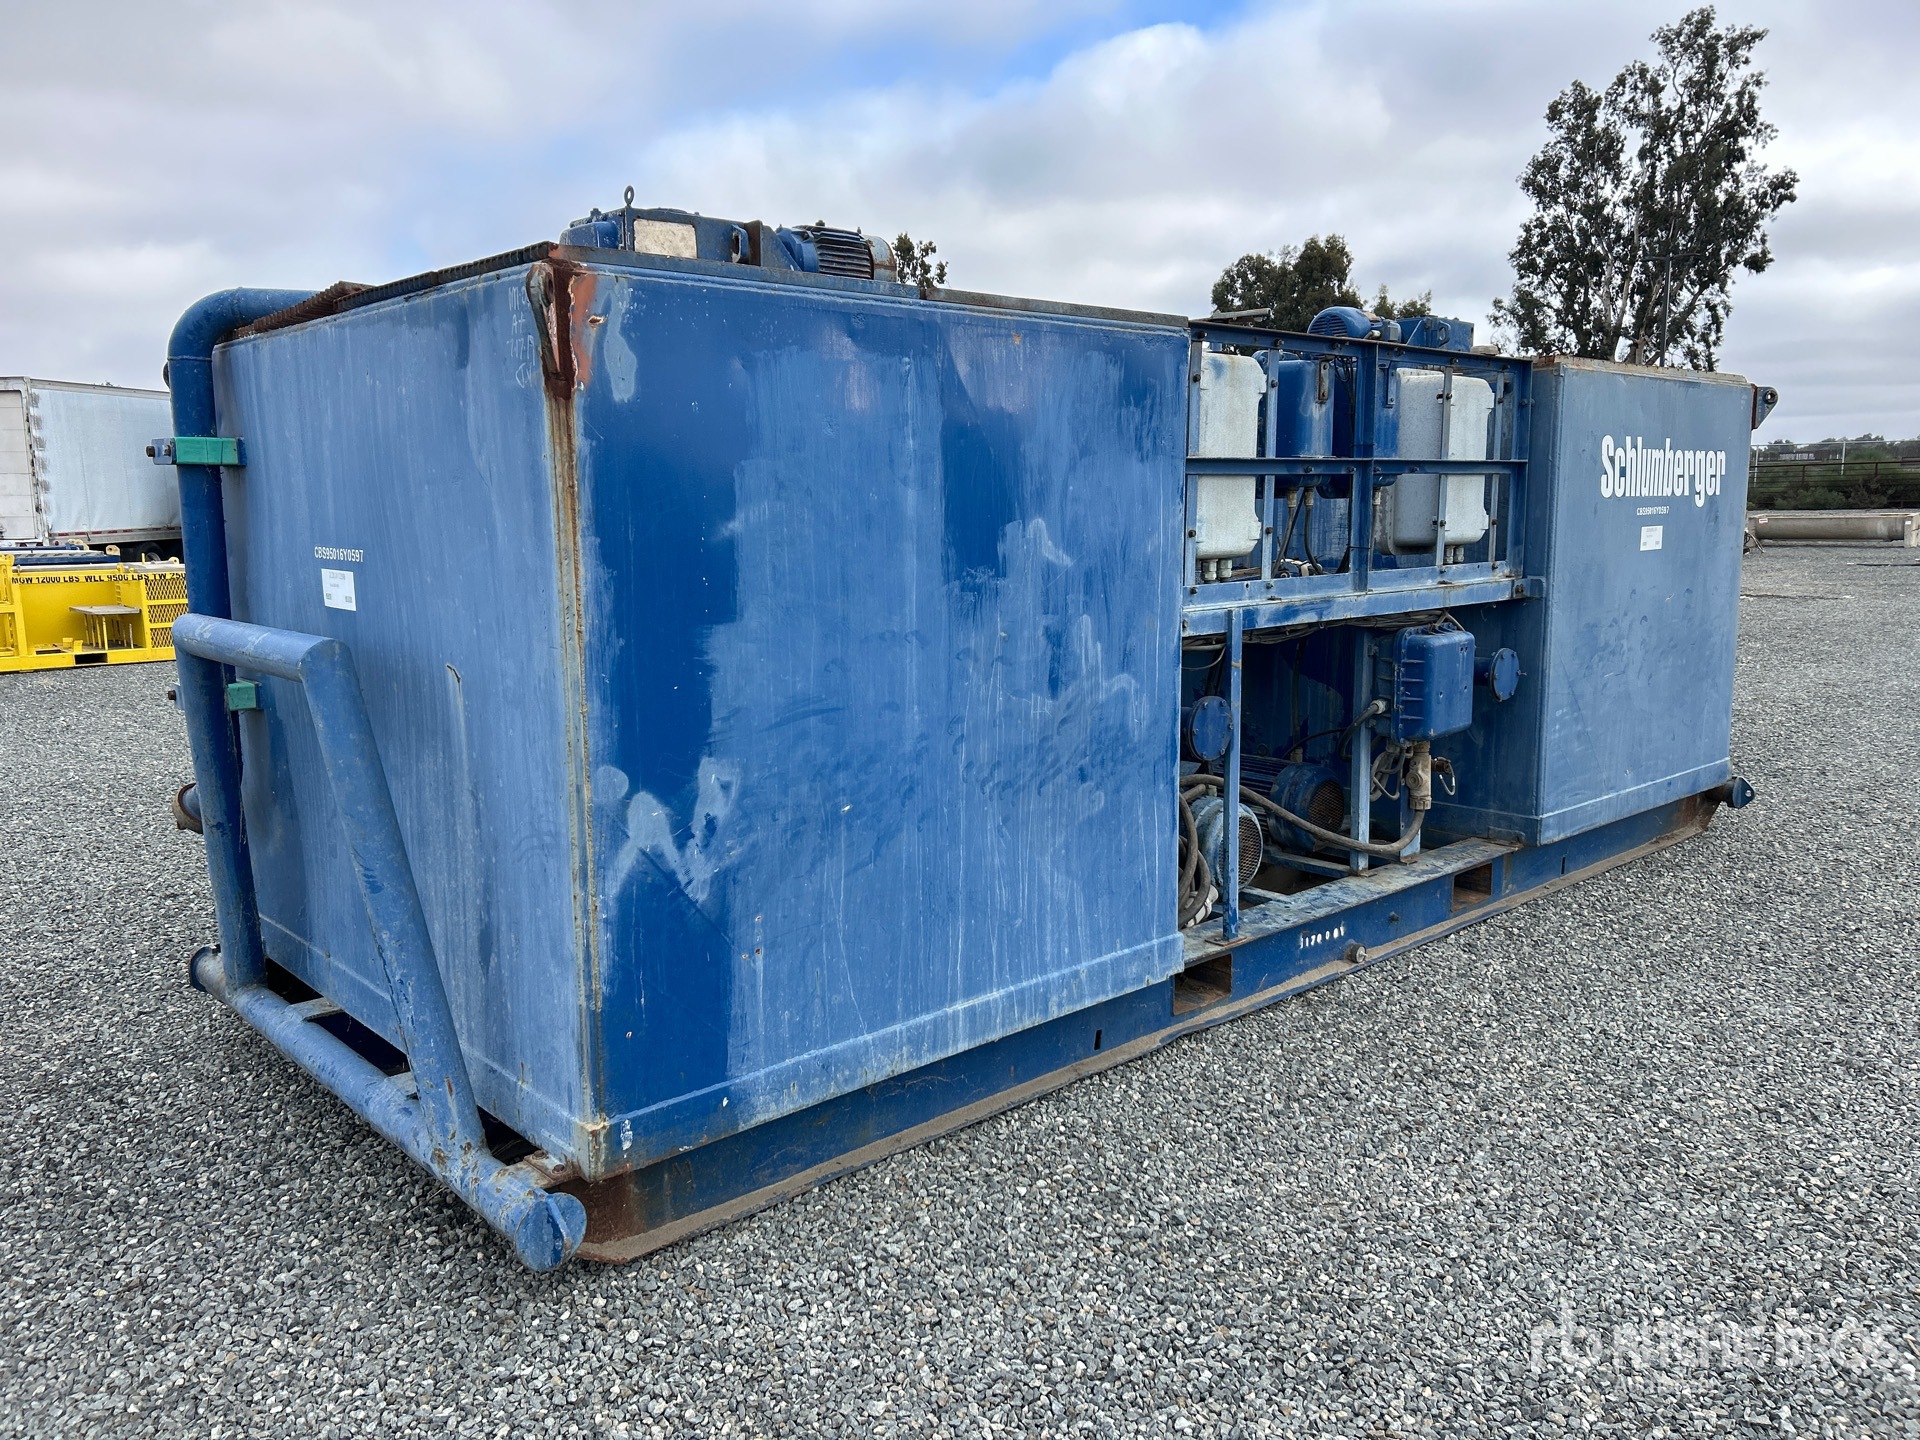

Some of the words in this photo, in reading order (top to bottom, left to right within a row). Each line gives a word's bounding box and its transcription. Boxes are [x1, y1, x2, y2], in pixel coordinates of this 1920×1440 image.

[1600, 435, 1726, 507] Schlumberger
[314, 547, 363, 562] CBS95016Y0597
[132, 573, 150, 581] LBS
